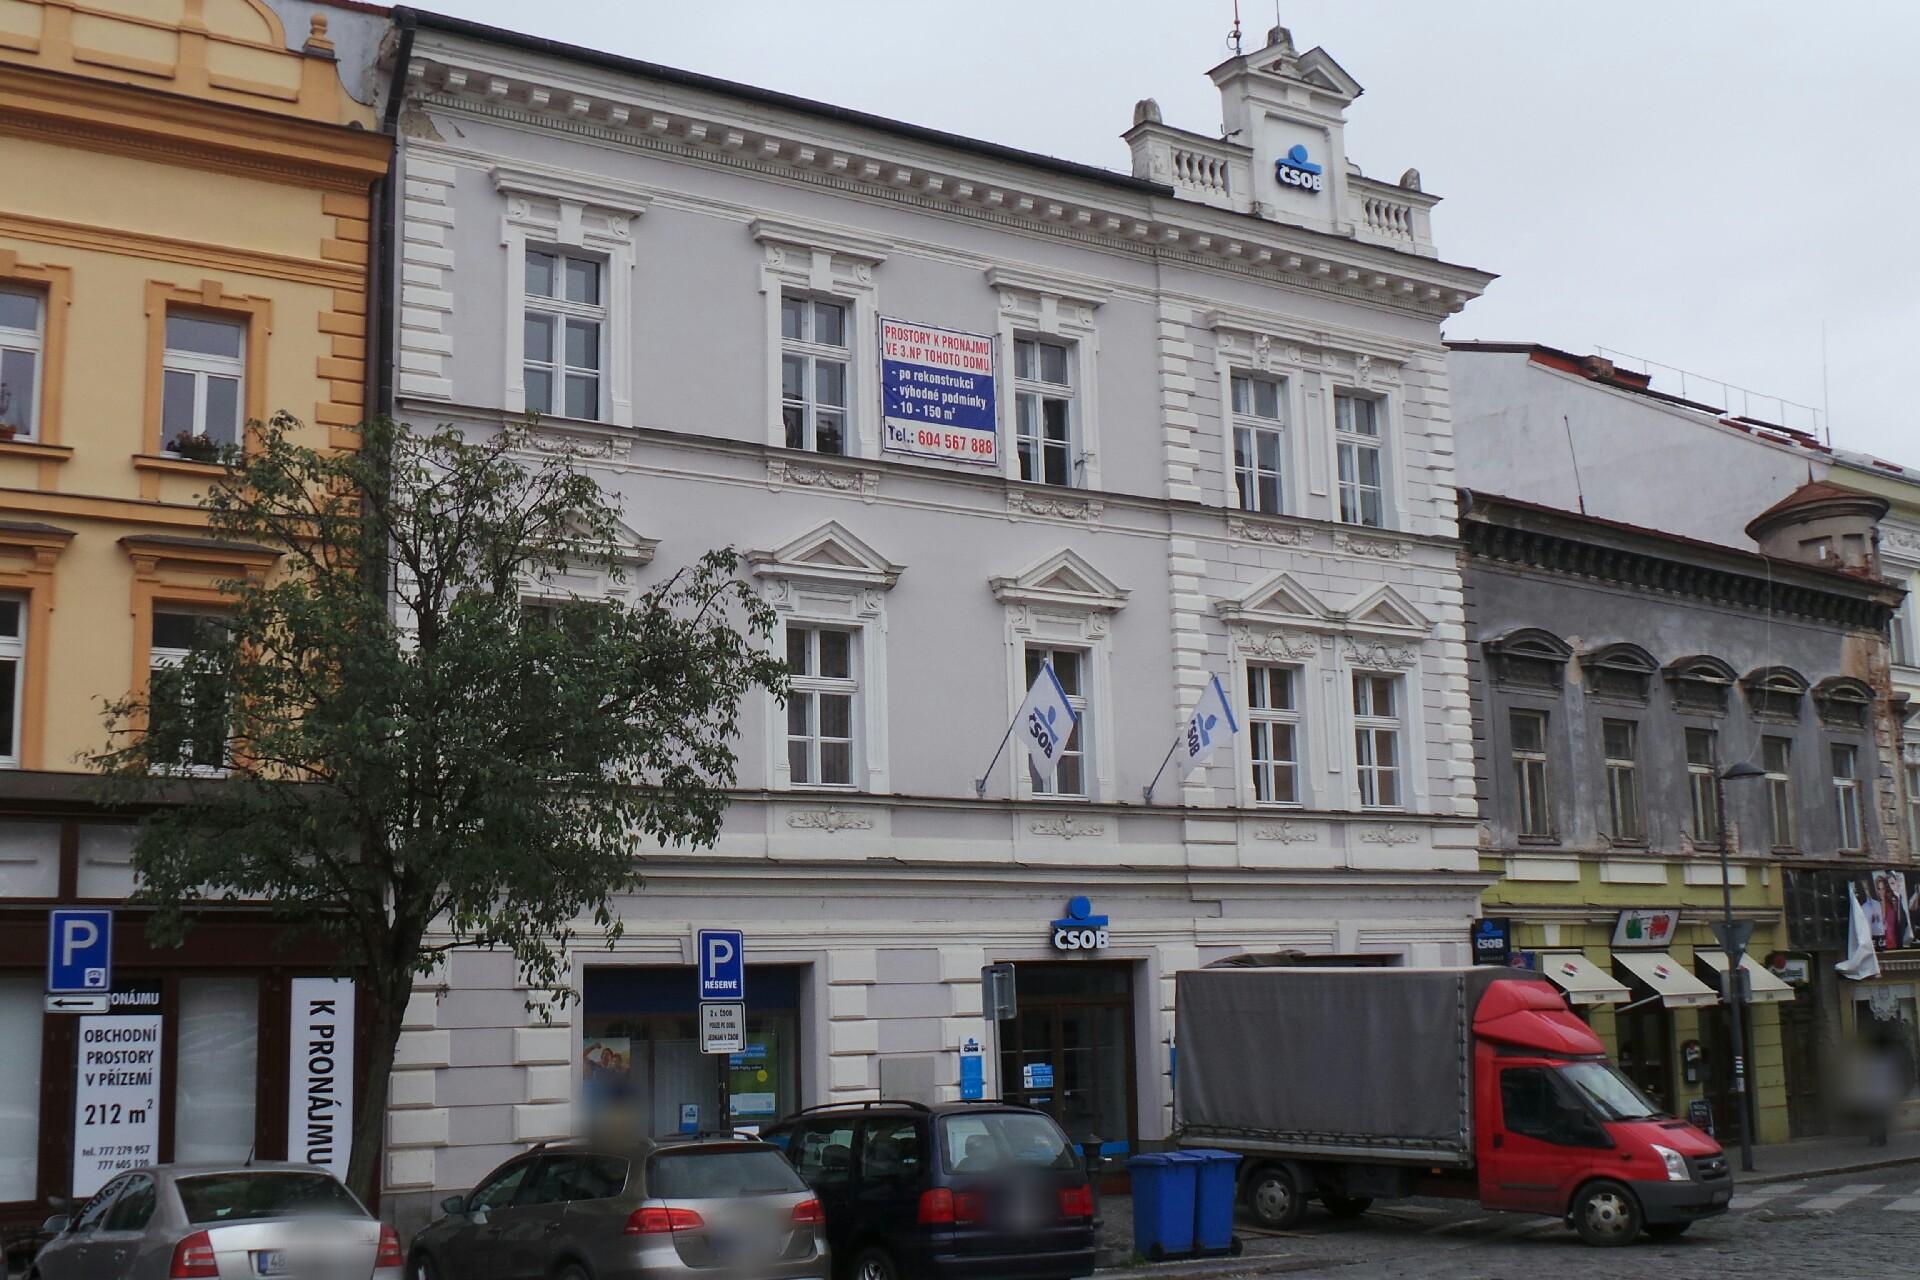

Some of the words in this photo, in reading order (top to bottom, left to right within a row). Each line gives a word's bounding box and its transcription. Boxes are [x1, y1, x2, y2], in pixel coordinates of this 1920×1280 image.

[1280, 164, 1322, 191] ČSOB
[885, 325, 931, 344] PROSTORY
[933, 335, 940, 347] K
[942, 335, 989, 356] PRONAJMU
[886, 342, 897, 356] VE
[901, 345, 922, 360] 3.NP
[925, 349, 960, 367] TOHOTO
[963, 355, 989, 371] DOMU
[899, 369, 911, 381] po
[913, 370, 974, 389] rekonstrukci
[899, 384, 939, 401] výhodné
[942, 392, 986, 410] podmínky
[900, 401, 913, 414] 10
[923, 404, 941, 418] 150
[888, 424, 914, 443] Tel.:
[918, 430, 940, 447] 604
[945, 434, 966, 450] 567
[971, 438, 993, 454] 888
[63, 919, 99, 967] P
[1055, 928, 1110, 950] ČSOB
[709, 939, 734, 978] P
[309, 1000, 336, 1016] K
[84, 1023, 158, 1043] OBCHODNÍ
[87, 1050, 154, 1065] PROSTORY
[85, 1073, 96, 1087] V
[99, 1067, 153, 1086] PŘÍZEMÍ
[306, 1024, 342, 1165] PRONÁJMU
[84, 1103, 122, 1125] 212
[98, 1146, 115, 1156] 777
[97, 1160, 114, 1170] 777
